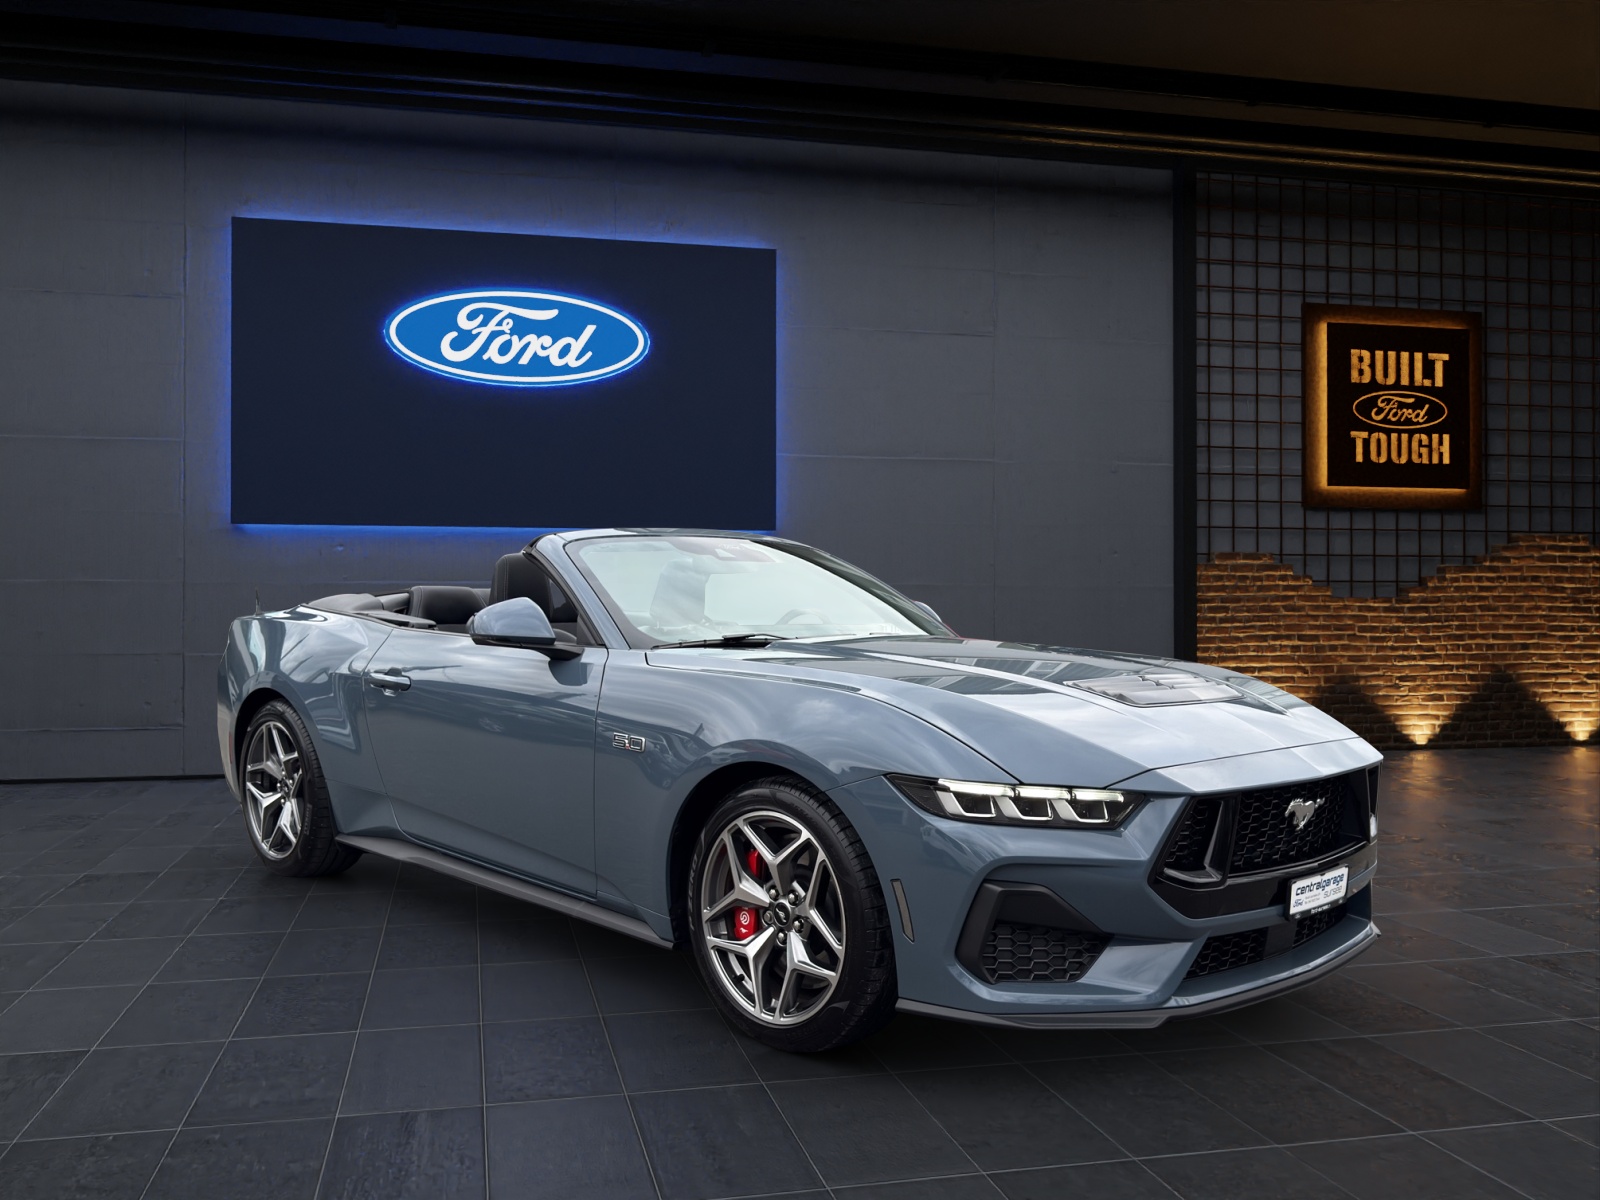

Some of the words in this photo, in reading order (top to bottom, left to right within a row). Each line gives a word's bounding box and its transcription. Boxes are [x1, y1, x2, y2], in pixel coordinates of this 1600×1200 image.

[440, 302, 597, 368] Ford
[1350, 349, 1450, 387] BUILT
[1371, 395, 1430, 423] Ford
[1350, 431, 1450, 464] TOUGH
[613, 732, 645, 752] 5.0
[1295, 873, 1344, 896] centralgarage
[1323, 885, 1343, 899] sursee
